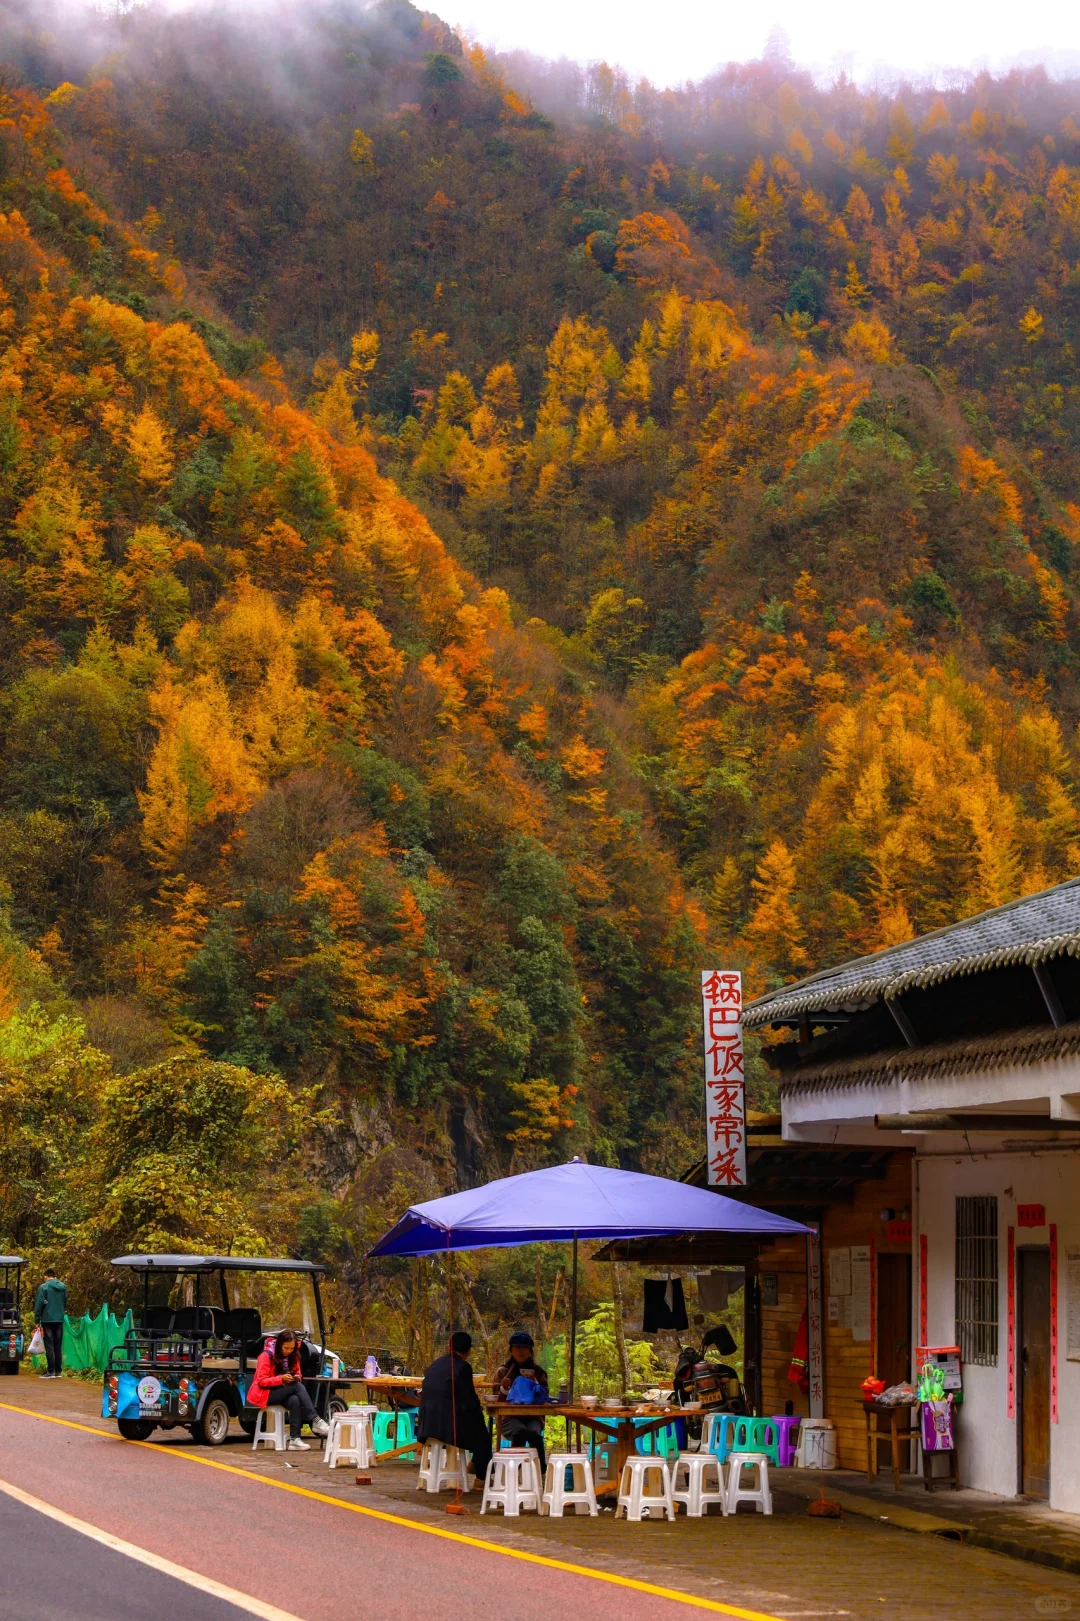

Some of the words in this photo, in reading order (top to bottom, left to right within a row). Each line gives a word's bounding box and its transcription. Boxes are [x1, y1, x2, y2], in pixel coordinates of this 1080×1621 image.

[702, 971, 744, 1185] 锅巴饭家常菜
